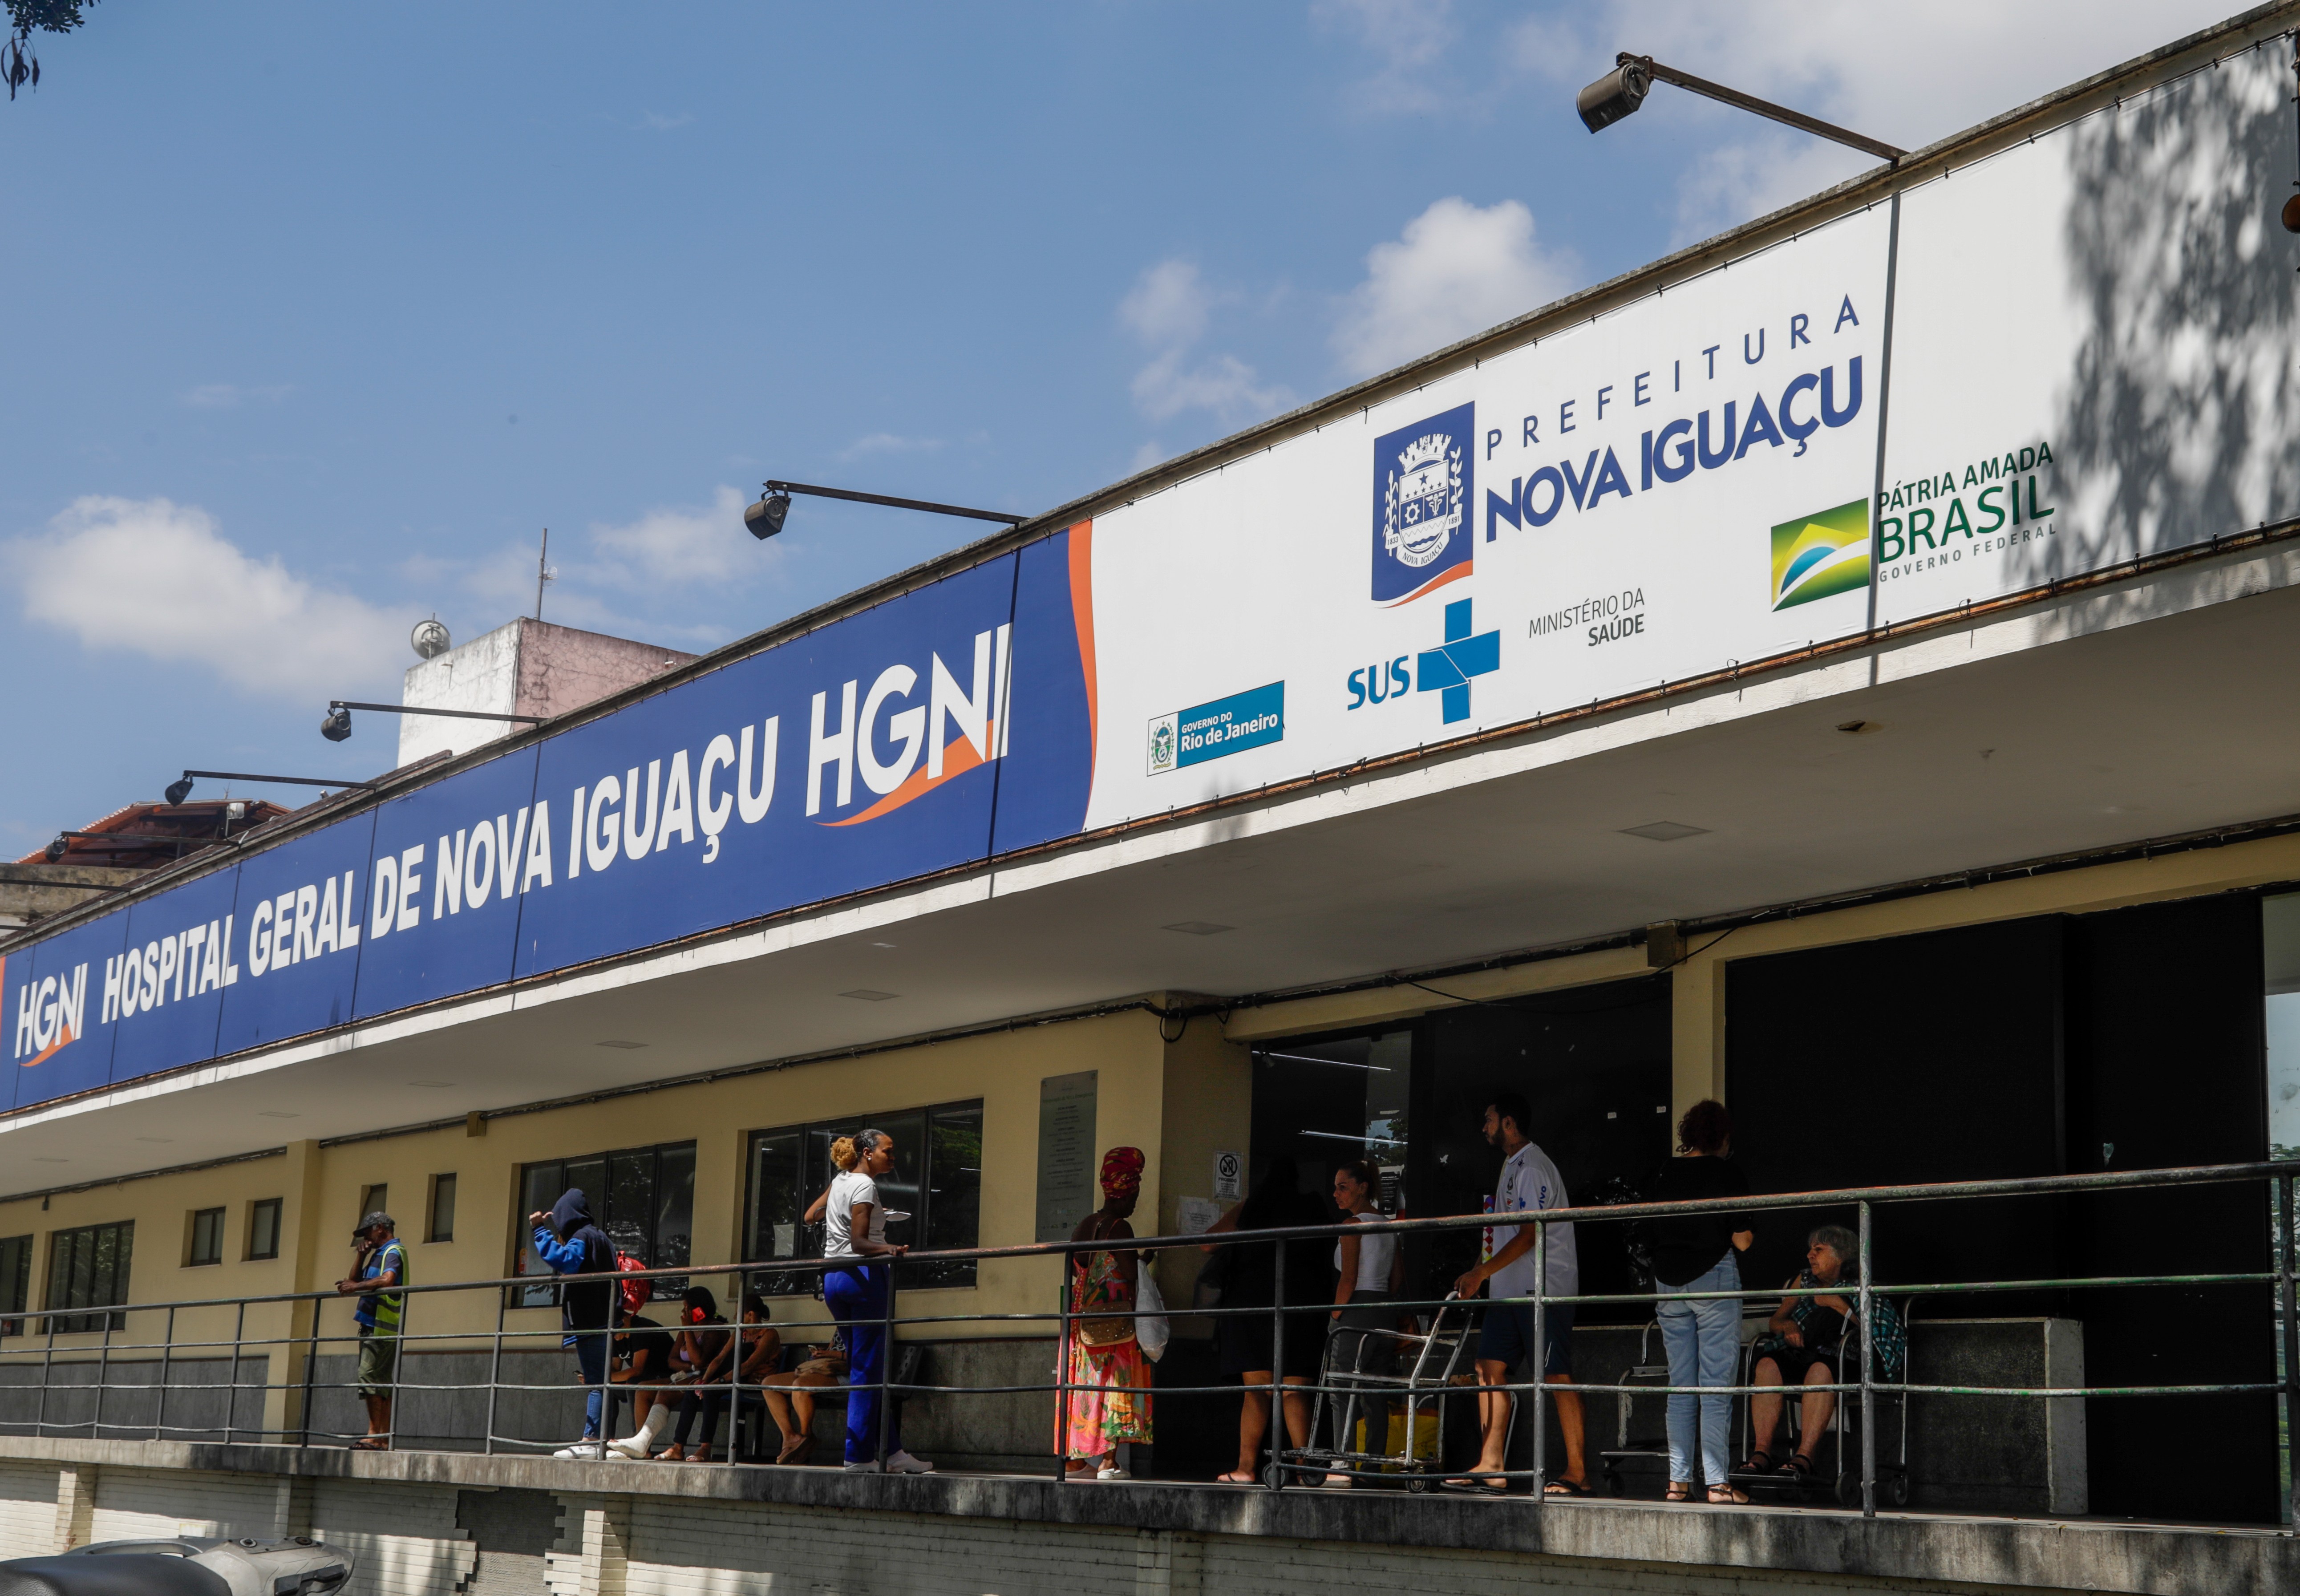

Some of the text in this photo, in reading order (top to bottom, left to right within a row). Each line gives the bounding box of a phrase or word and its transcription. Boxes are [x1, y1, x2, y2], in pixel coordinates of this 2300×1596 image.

[1487, 293, 1859, 461] PREFEITURA
[1486, 355, 1862, 543] NOVA IGUAÇU
[1878, 442, 2053, 515] PÁTRIA AMADA
[1387, 536, 1399, 546] 1833
[1448, 516, 1460, 525] 1891
[1879, 474, 2055, 563] BRASIL
[1402, 542, 1443, 565] NOVA IGUAÇU
[1879, 523, 2056, 582] GOVERNO FEDERAL
[1529, 587, 1644, 638] MINISTÉRIO DA
[1588, 613, 1645, 647] SAÚDE
[1348, 655, 1410, 711] SUS
[806, 622, 1012, 817] HGNI
[1181, 712, 1232, 733] GOVERNO DO
[1181, 713, 1279, 752] Rio de Janeiro
[101, 715, 779, 1024] HOSPITAL GERAL DE NOVA IGUAÇU
[14, 962, 88, 1058] HGNI
